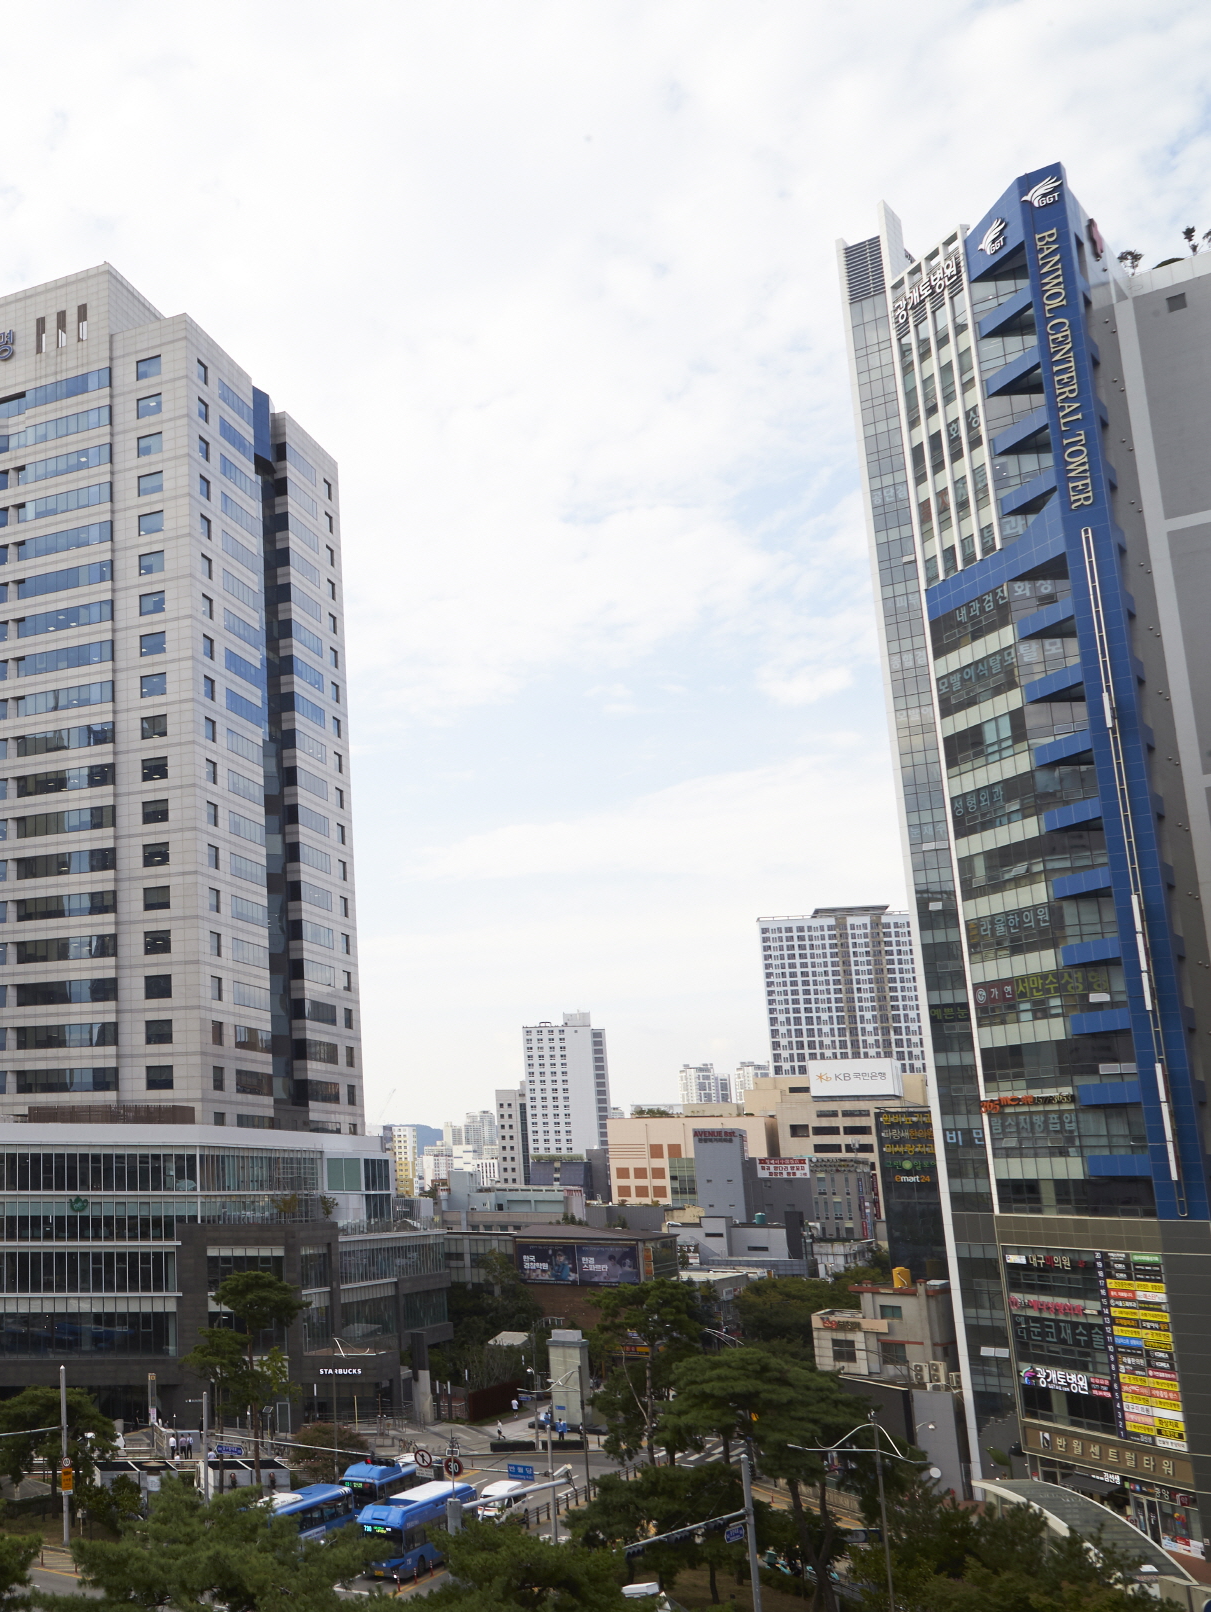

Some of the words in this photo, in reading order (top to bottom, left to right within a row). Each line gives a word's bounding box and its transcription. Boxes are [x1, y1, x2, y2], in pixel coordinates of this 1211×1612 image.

[1038, 191, 1061, 207] GGT
[989, 235, 1006, 255] GGT
[1035, 227, 1068, 317] BANWOL
[894, 256, 959, 324] 광개토병원
[1046, 317, 1082, 432] CENTERAL
[1063, 431, 1095, 510] TOWER
[956, 585, 1009, 624] 내과검진
[953, 783, 1004, 817] 성형외과
[834, 1073, 851, 1081] KB
[852, 1072, 887, 1081] 국민은행
[895, 1174, 930, 1183] emart24
[1029, 1319, 1106, 1350] 눈코재수술
[1035, 1367, 1089, 1395] 광개토병원
[449, 1462, 459, 1473] 30
[508, 1466, 533, 1475] 반월당
[1056, 1437, 1175, 1476] 반월센트럴타워
